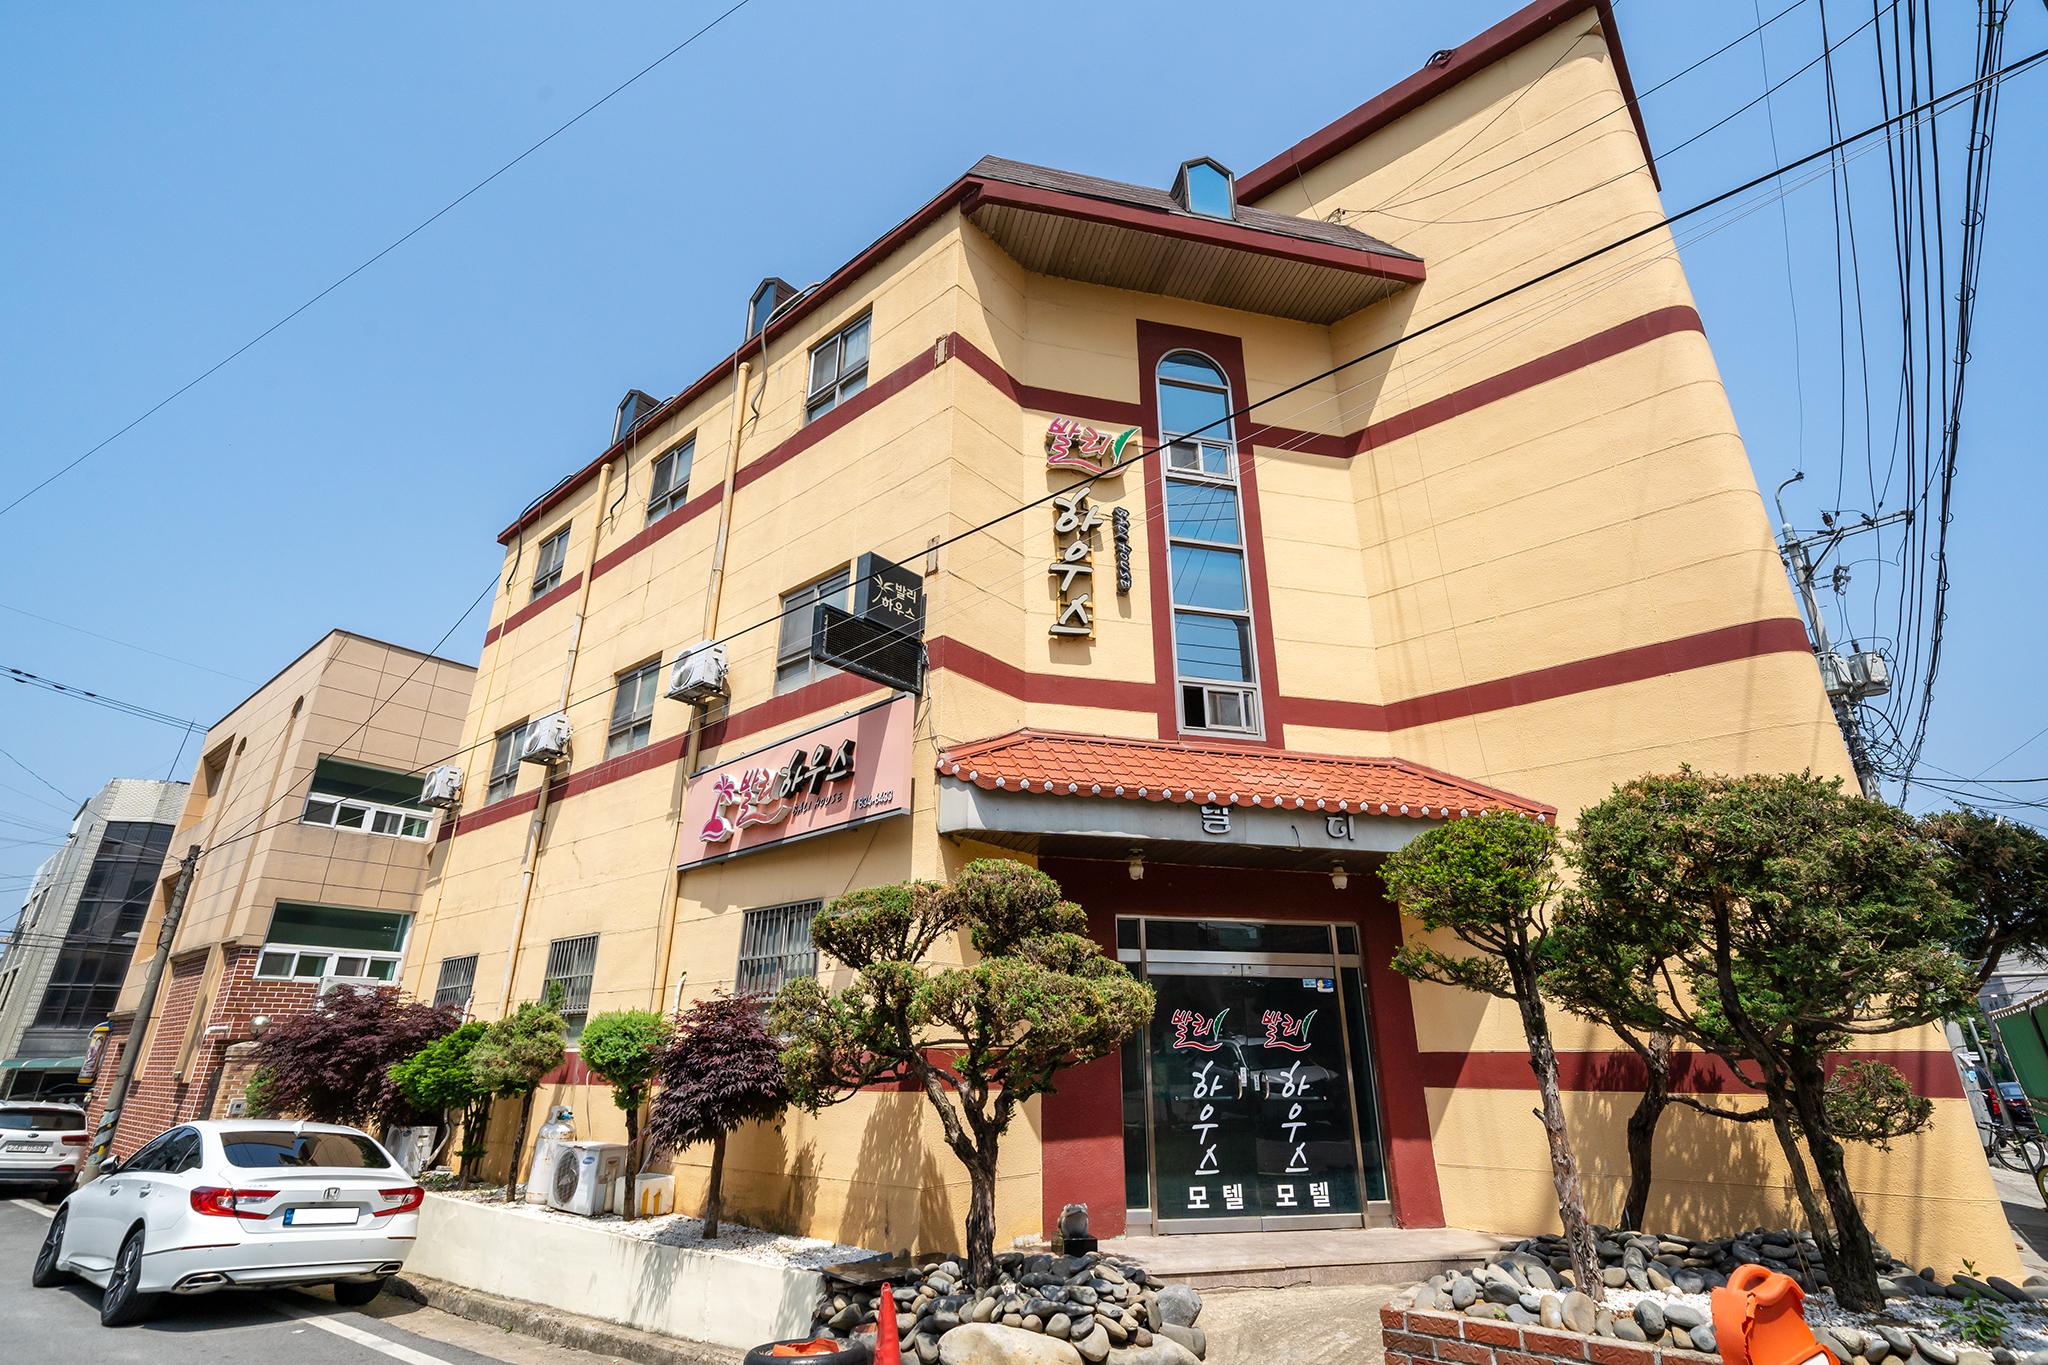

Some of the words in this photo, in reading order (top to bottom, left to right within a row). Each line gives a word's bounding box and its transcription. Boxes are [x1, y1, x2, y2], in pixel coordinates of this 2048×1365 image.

[1047, 416, 1126, 478] 발리
[1049, 486, 1104, 636] 하우스
[1116, 543, 1132, 592] HOUSE
[882, 596, 916, 621] 하우스
[895, 582, 917, 604] 발리
[736, 767, 788, 828] 발리
[779, 739, 856, 799] 하우스
[814, 792, 844, 809] HOUSE
[1172, 1008, 1223, 1051] 발리
[1261, 1009, 1311, 1052] 발리
[1191, 1060, 1224, 1175] 하우스
[1280, 1060, 1310, 1174] 하우스
[1187, 1183, 1244, 1210] 모텔
[1276, 1181, 1331, 1209] 모텔
